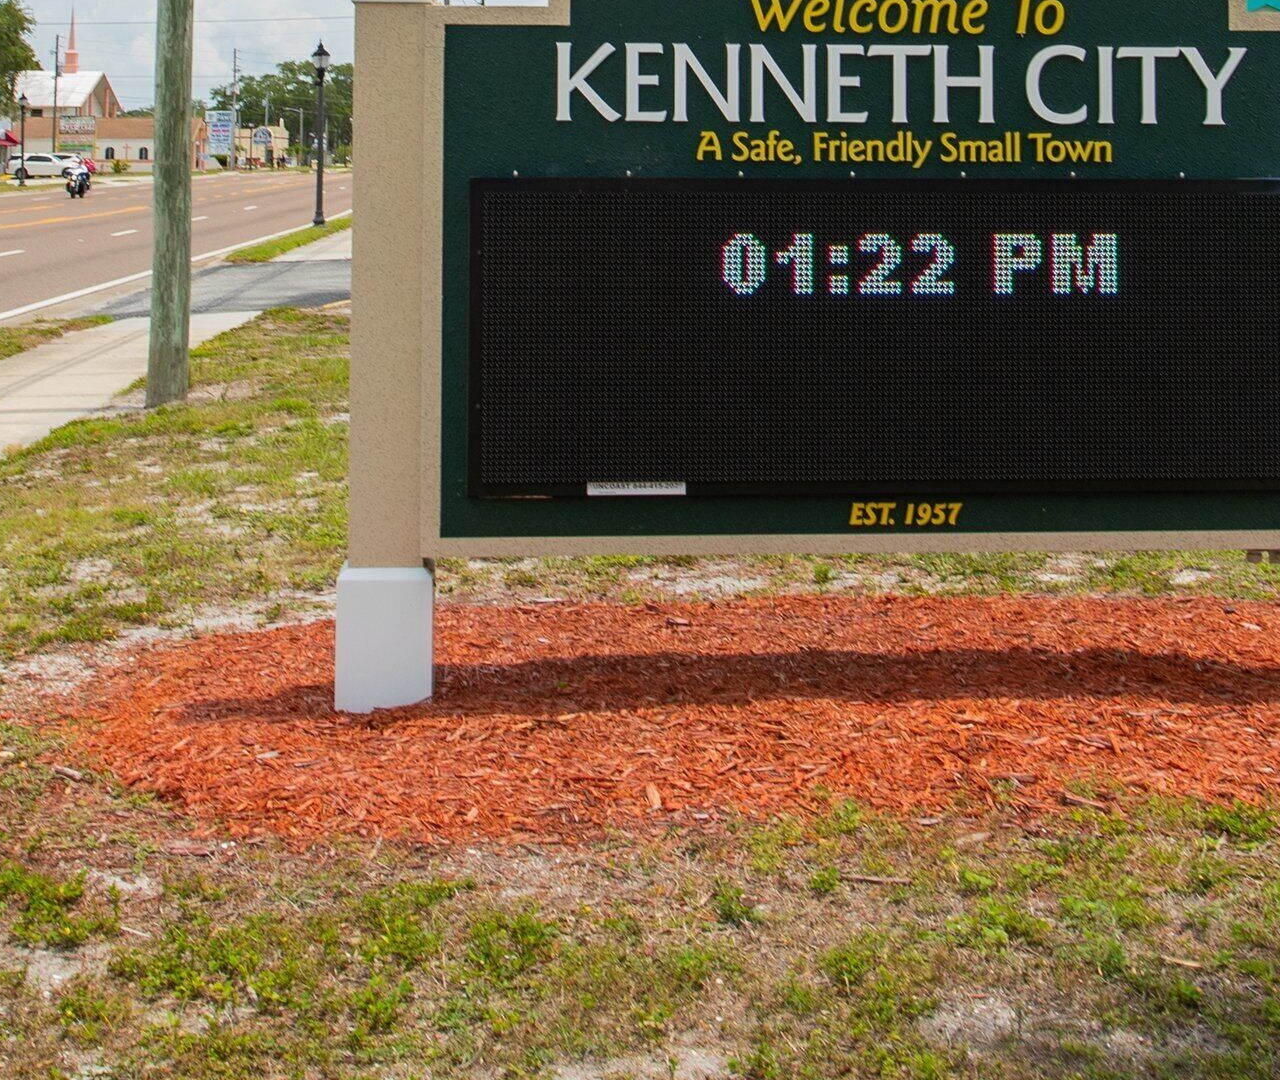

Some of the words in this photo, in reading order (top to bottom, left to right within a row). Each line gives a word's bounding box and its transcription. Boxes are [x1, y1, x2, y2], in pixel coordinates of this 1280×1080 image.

[555, 41, 995, 124] KENNETH
[1025, 44, 1248, 126] CITY
[696, 131, 723, 162] A
[731, 130, 802, 166] Safe,
[813, 130, 933, 169] Friendly
[940, 131, 1021, 163] Small
[1027, 132, 1113, 163] Town
[721, 233, 956, 295] 01:22
[992, 233, 1118, 295] PM
[849, 502, 896, 526] EST.
[904, 503, 964, 526] 1957
